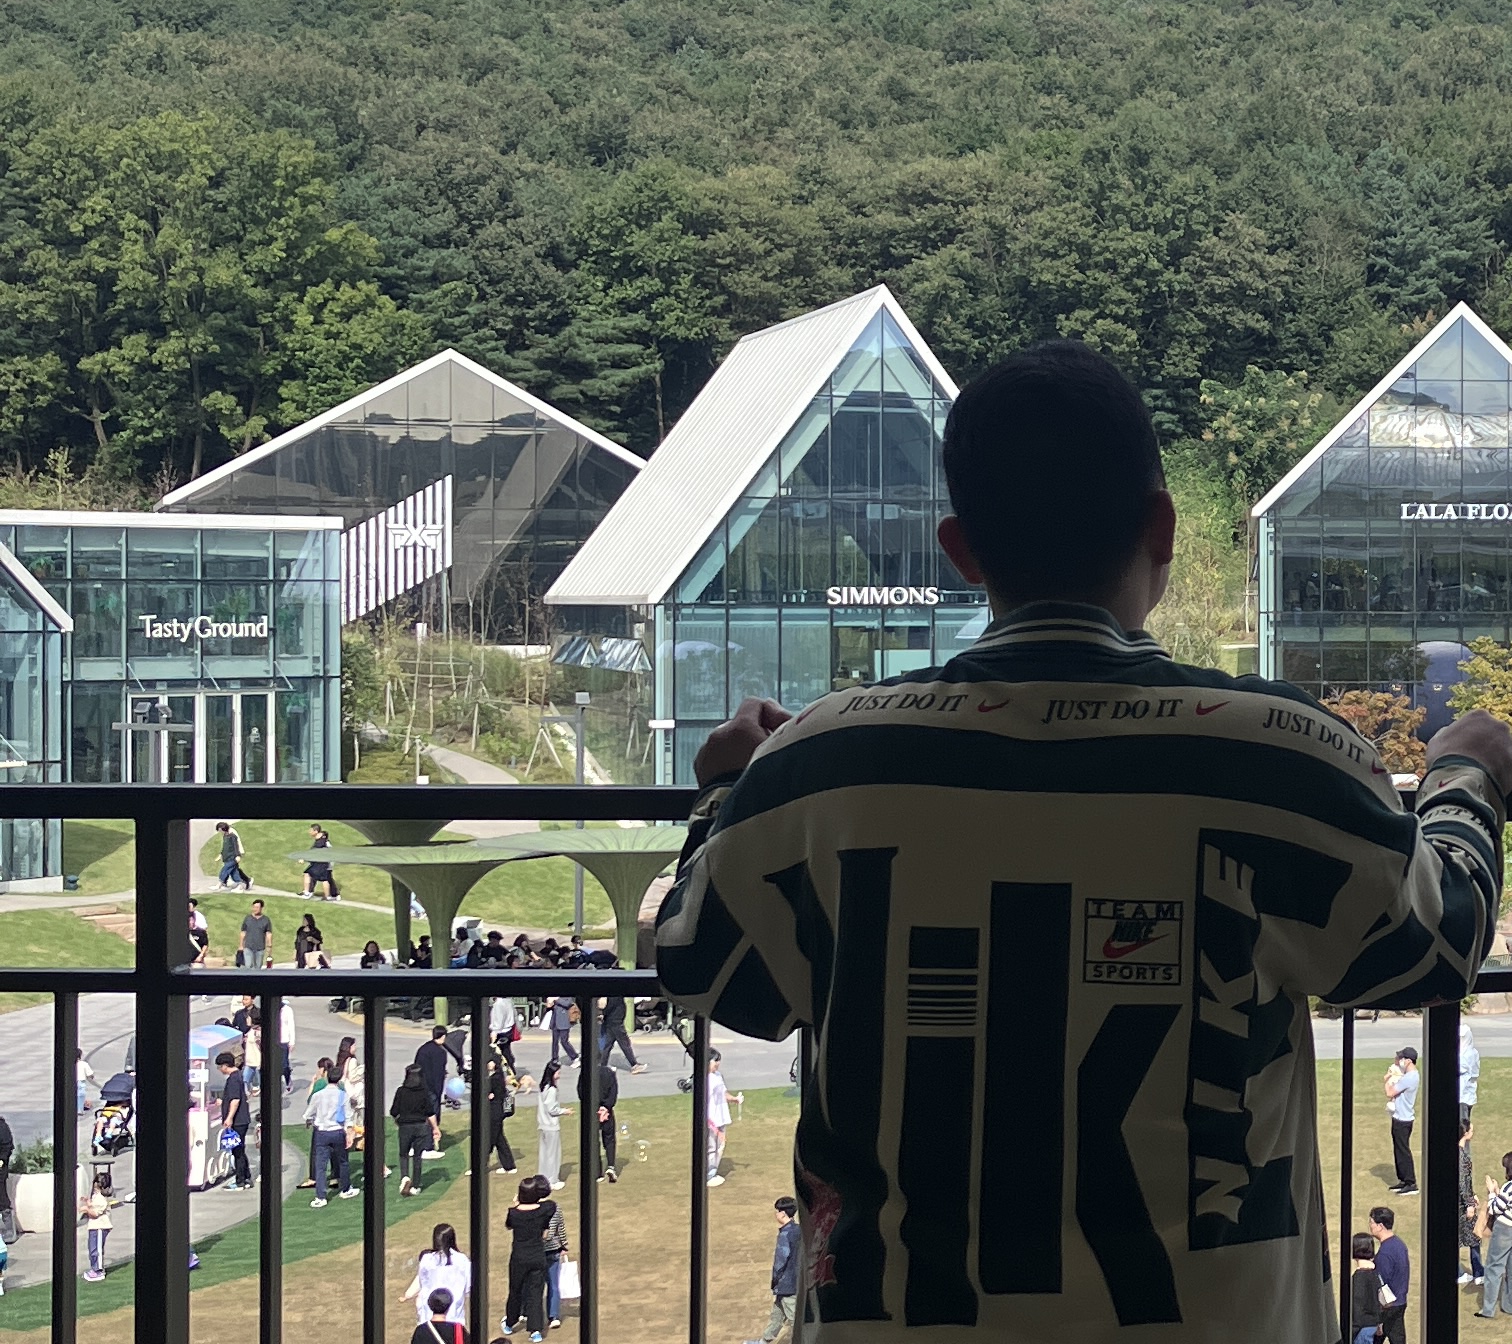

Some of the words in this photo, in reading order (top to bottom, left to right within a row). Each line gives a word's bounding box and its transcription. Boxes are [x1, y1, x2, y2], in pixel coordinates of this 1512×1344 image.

[1400, 503, 1458, 520] LALA
[386, 523, 444, 550] PXG
[827, 586, 939, 605] SIMMONS
[138, 614, 192, 643] Tasty
[194, 614, 268, 639] Ground
[839, 693, 900, 715] JUST
[895, 692, 935, 712] DO
[938, 694, 969, 712] IT
[1042, 699, 1107, 725] JUST
[1111, 699, 1149, 720] DO
[1156, 698, 1183, 718] IT
[1263, 707, 1316, 737] JUST
[1318, 723, 1344, 751] DO
[1347, 743, 1365, 764] IT
[1091, 900, 1175, 920] TEAM
[1093, 964, 1173, 981] SPORTS
[1193, 842, 1258, 1224] NIKE
